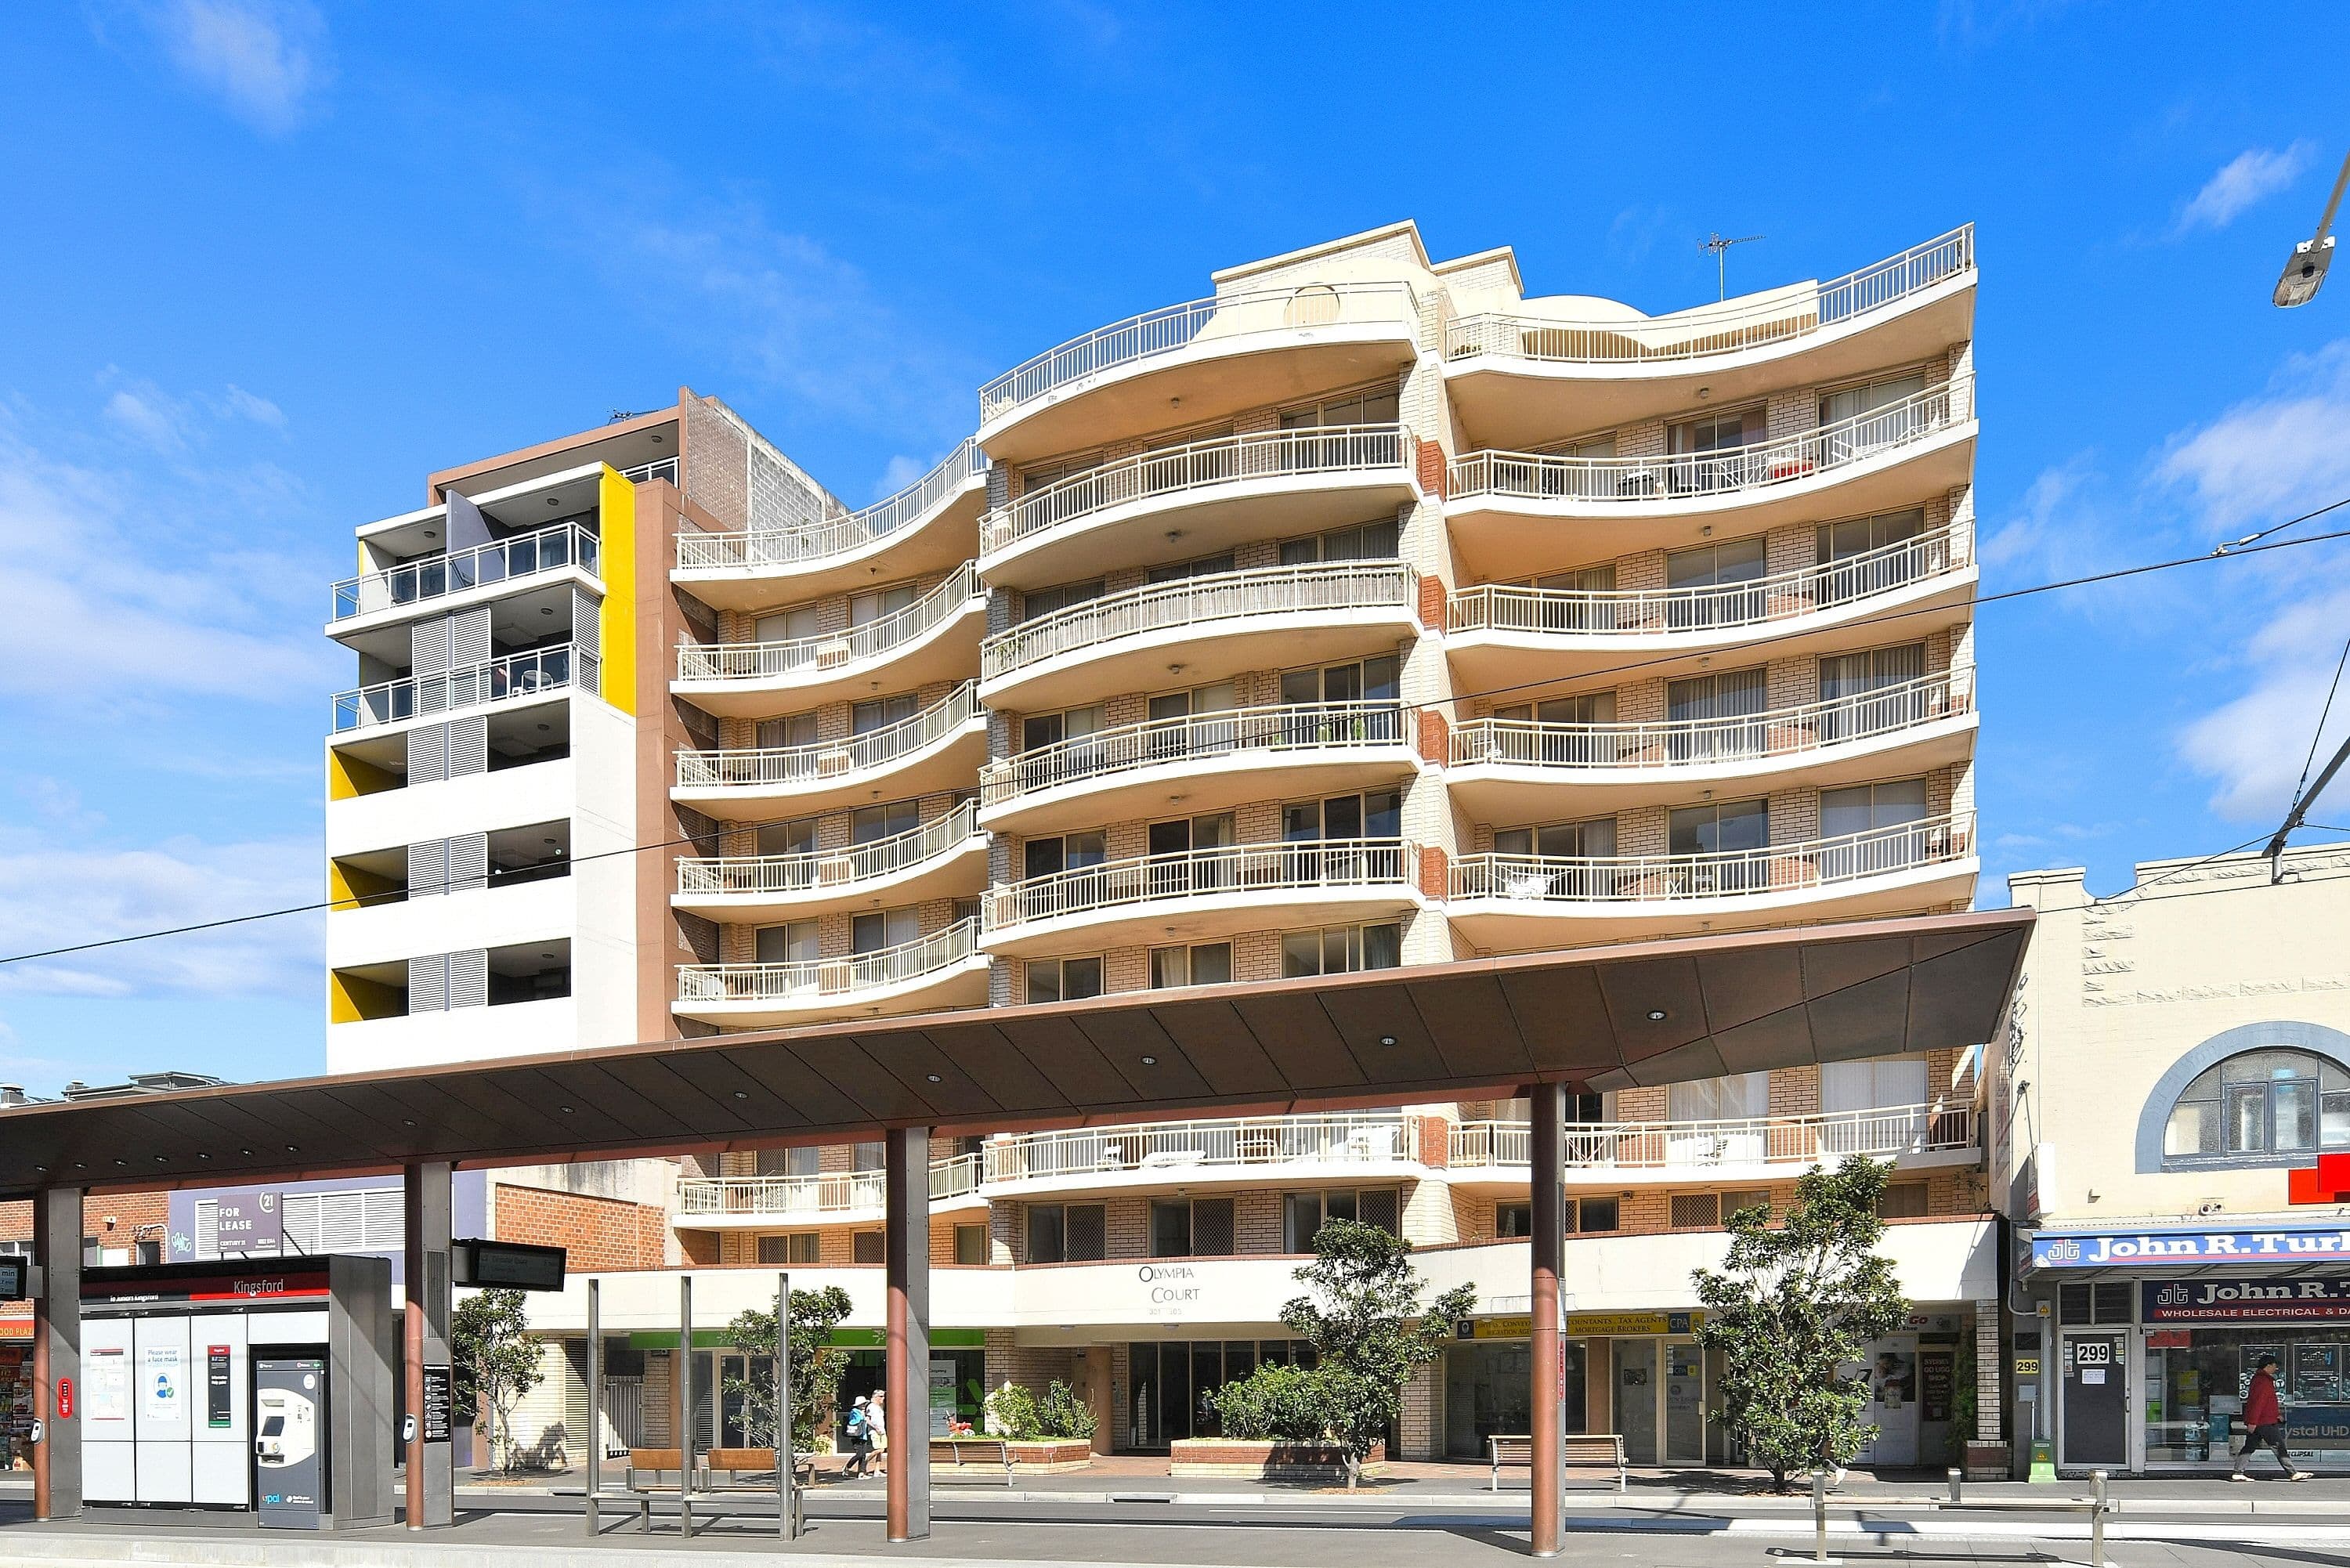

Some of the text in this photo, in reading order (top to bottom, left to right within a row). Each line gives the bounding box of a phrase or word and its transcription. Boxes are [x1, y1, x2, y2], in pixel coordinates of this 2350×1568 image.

[219, 1207, 240, 1218] FOR
[219, 1219, 252, 1231] LEASE
[2088, 1236, 2199, 1263] John
[1138, 1266, 1195, 1283] OLYMPIA
[233, 1278, 284, 1296] Kingsford
[2196, 1282, 2293, 1303] John
[1152, 1287, 1201, 1304] COURT
[1668, 1317, 1690, 1328] CPA
[1908, 1316, 1929, 1324] GO
[2079, 1345, 2109, 1361] 299
[2017, 1361, 2038, 1371] 299
[2321, 1425, 2349, 1436] UHD
